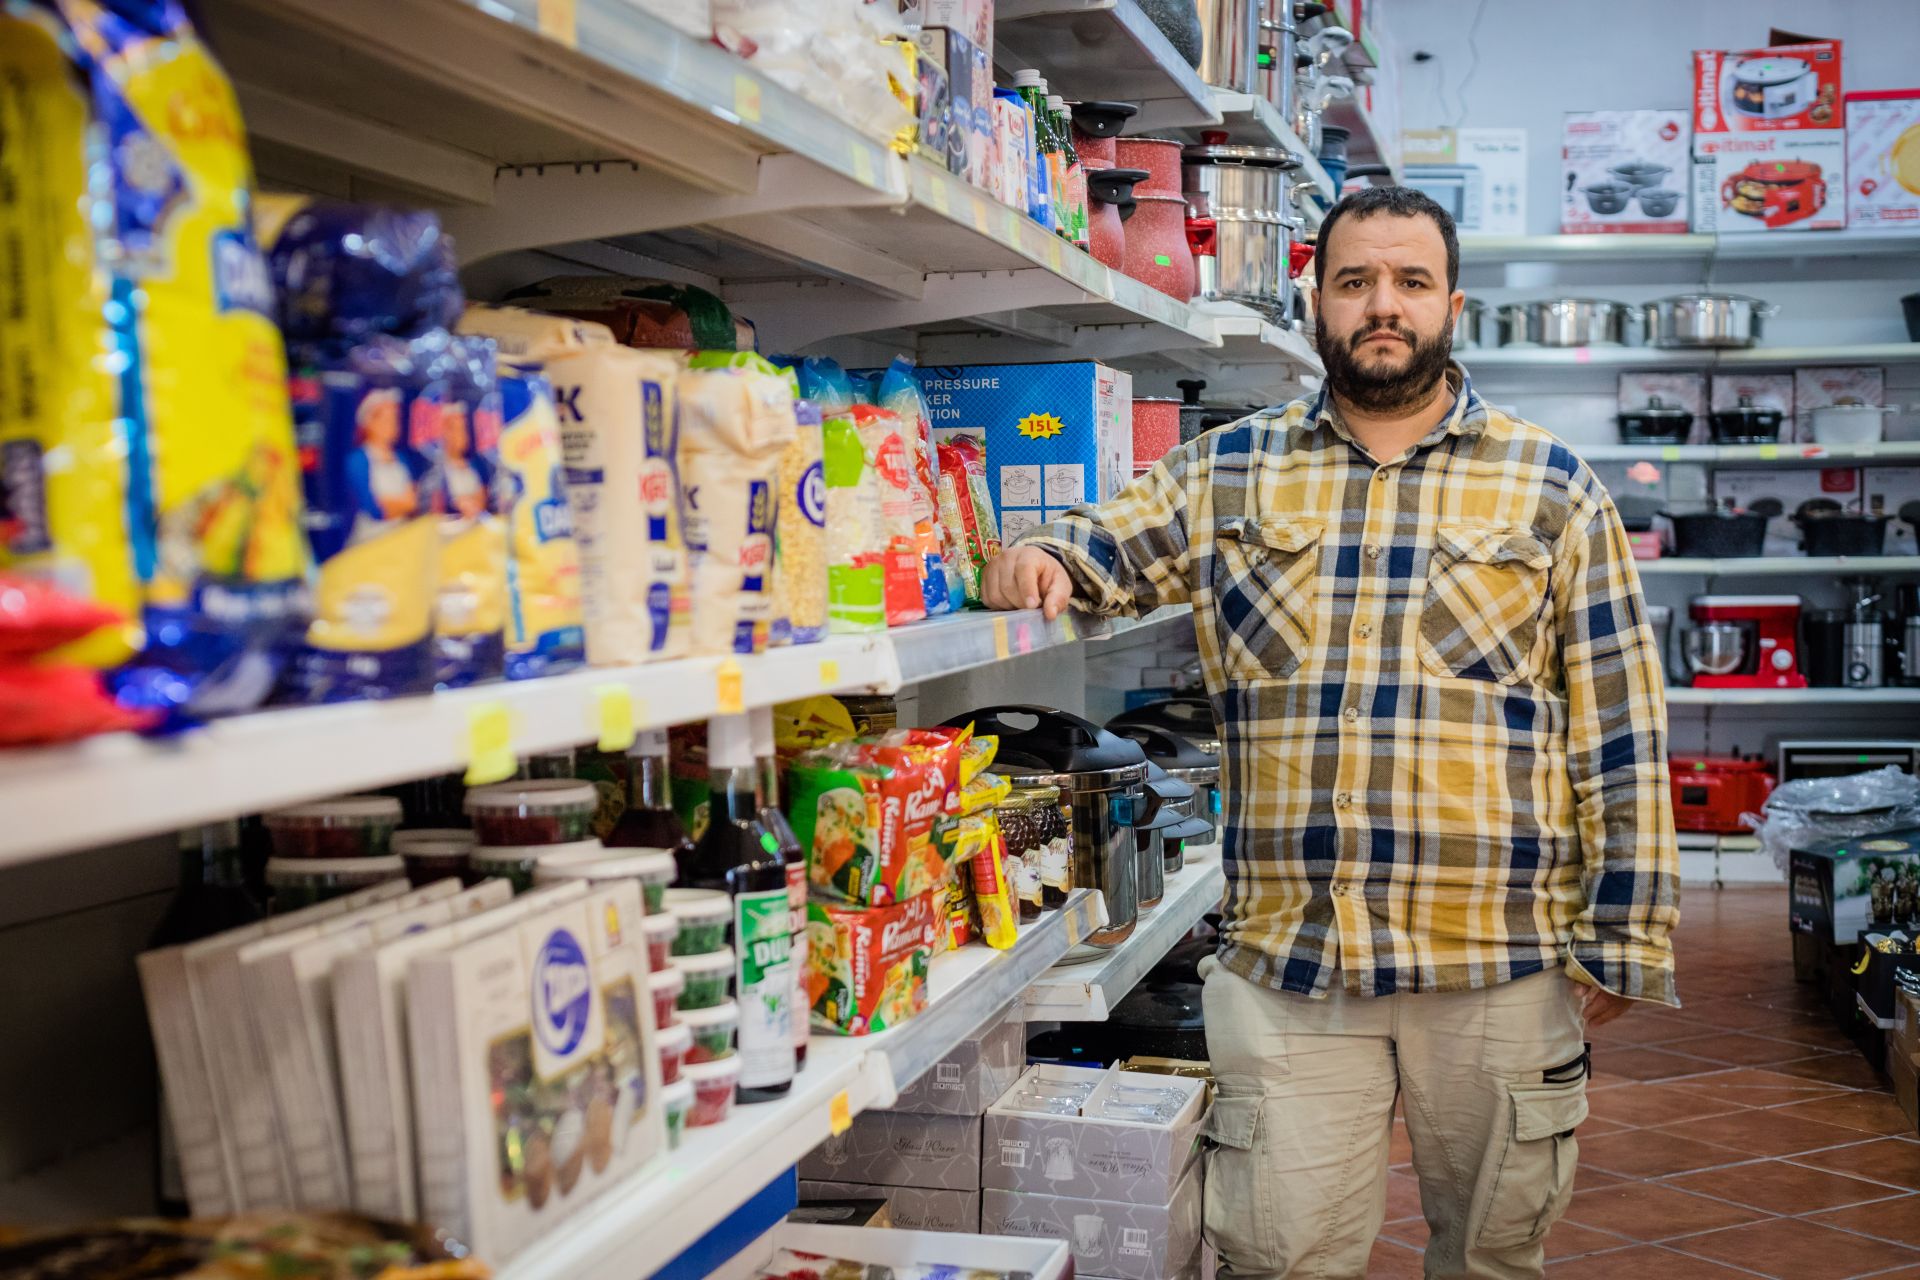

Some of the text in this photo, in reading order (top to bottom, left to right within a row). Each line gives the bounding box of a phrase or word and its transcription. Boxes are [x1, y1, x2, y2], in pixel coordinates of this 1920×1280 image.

[925, 377, 1000, 391] PRESSURE
[1028, 420, 1054, 433] 15L
[880, 796, 899, 867] Ramen
[855, 925, 873, 998] Ramen
[996, 1216, 1060, 1236] Glass Ware
